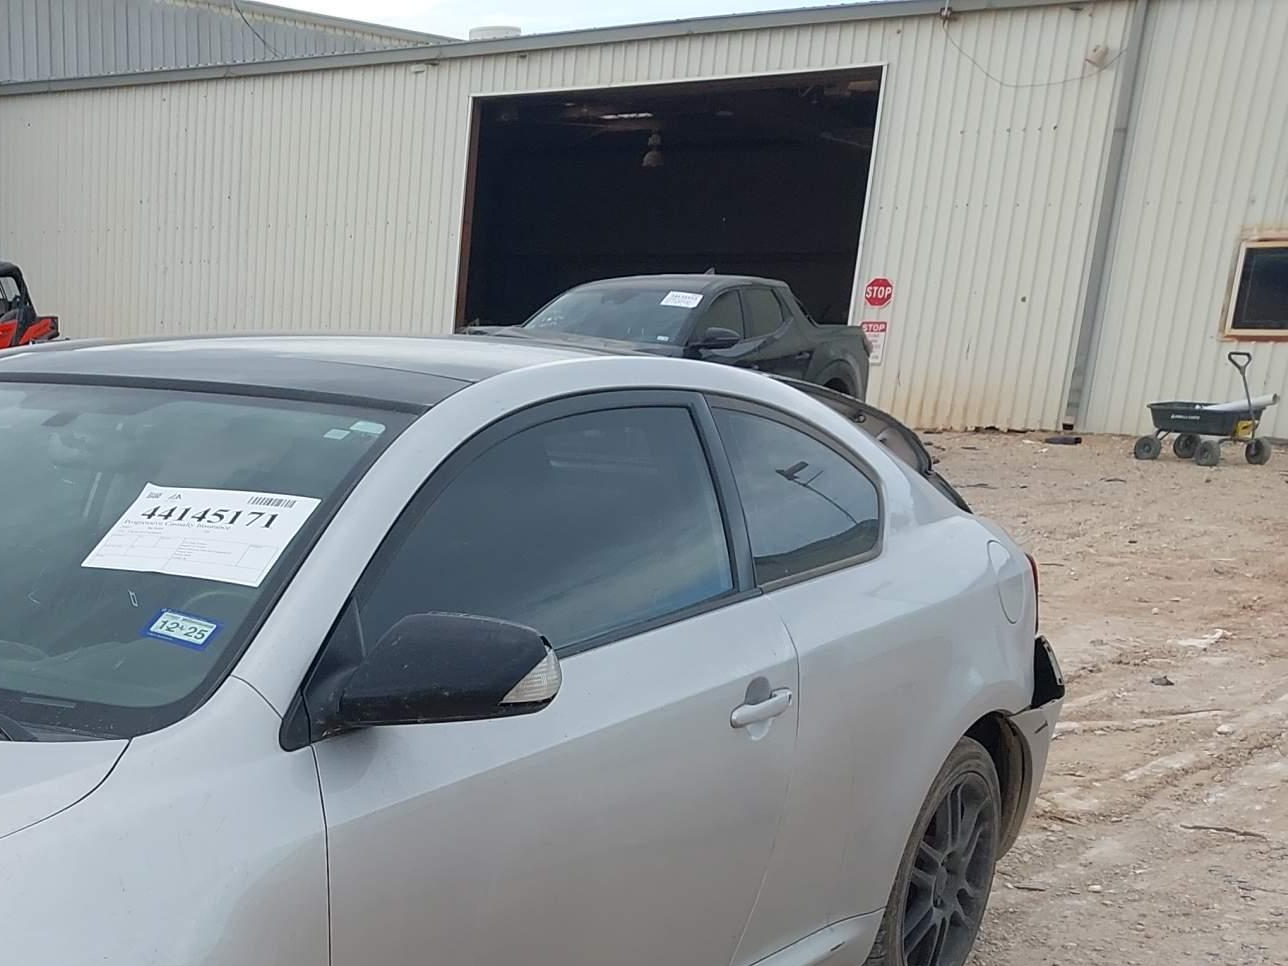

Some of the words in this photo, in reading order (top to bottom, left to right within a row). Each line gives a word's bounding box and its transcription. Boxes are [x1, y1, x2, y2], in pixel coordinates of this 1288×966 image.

[865, 286, 892, 298] STOP
[862, 324, 885, 332] STOP
[140, 505, 280, 530] 44145171
